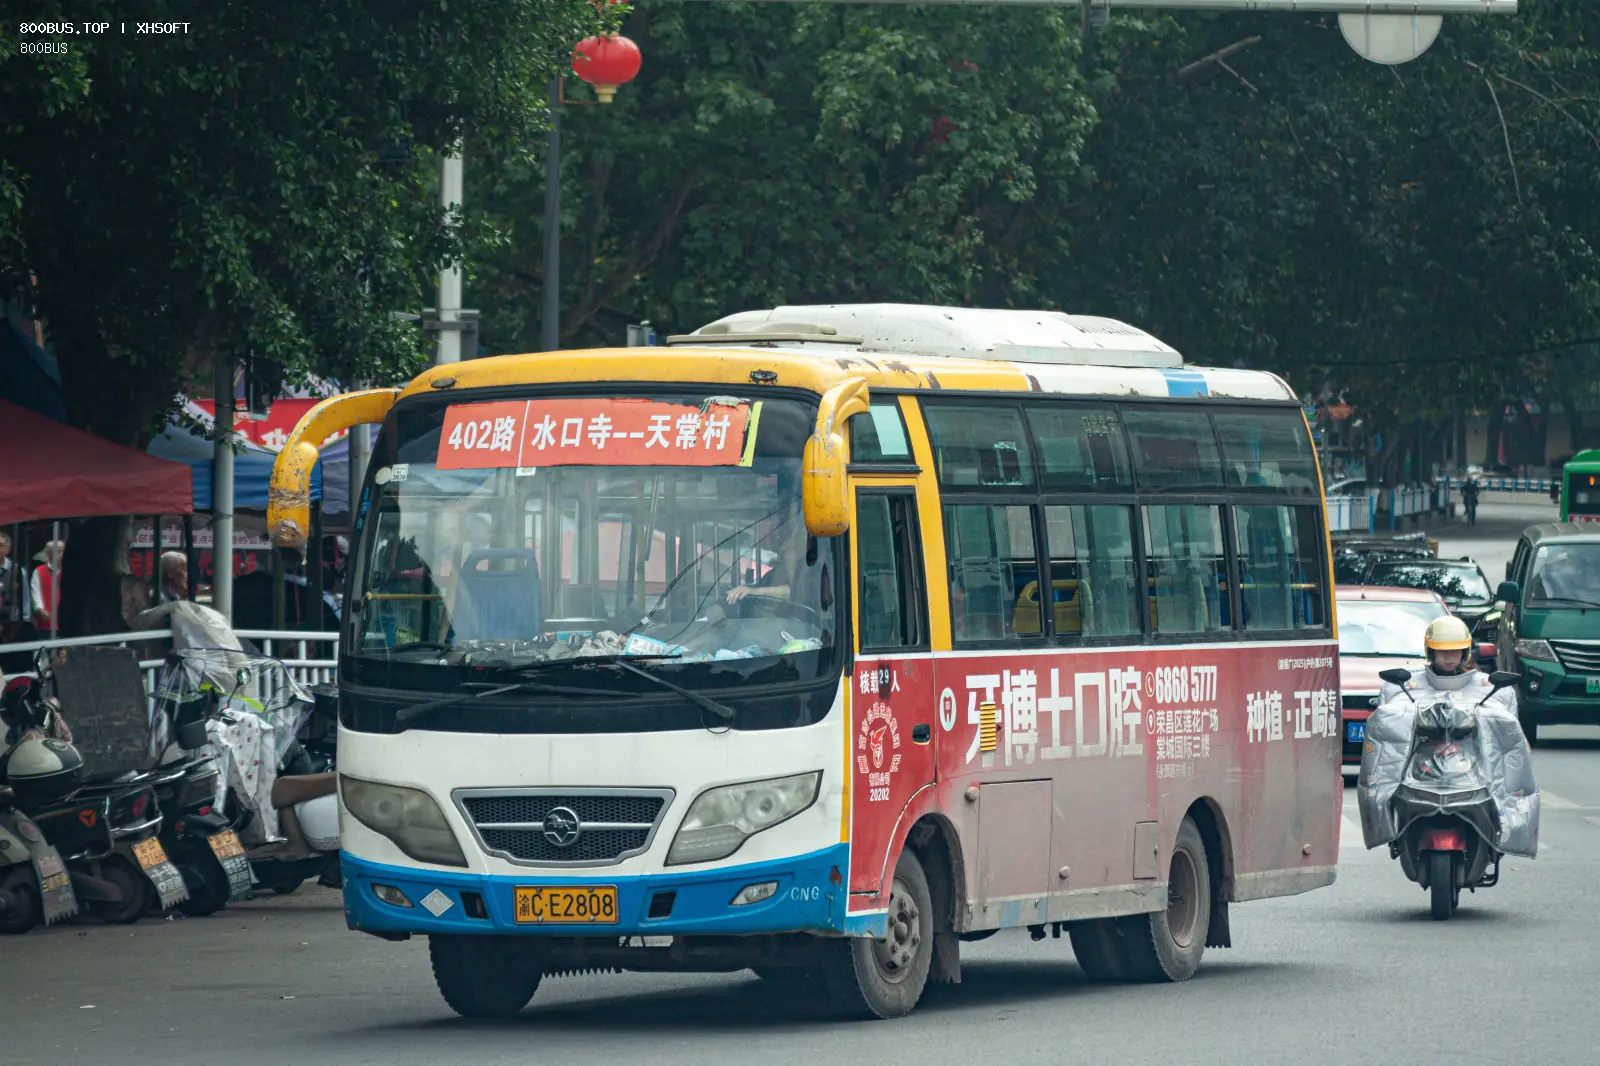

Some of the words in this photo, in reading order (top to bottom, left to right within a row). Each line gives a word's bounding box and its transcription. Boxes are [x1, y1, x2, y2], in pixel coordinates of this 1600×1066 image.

[448, 415, 516, 452] 402路
[1155, 665, 1189, 704] 6868
[965, 665, 1143, 768] 牙博士口腔
[1156, 708, 1219, 734] 荣昌区莲花广场
[1156, 734, 1211, 761] 棠城国际三楼
[869, 787, 890, 802] 20202
[518, 893, 614, 917] 渝C·E2808
[791, 886, 820, 901] CNG
